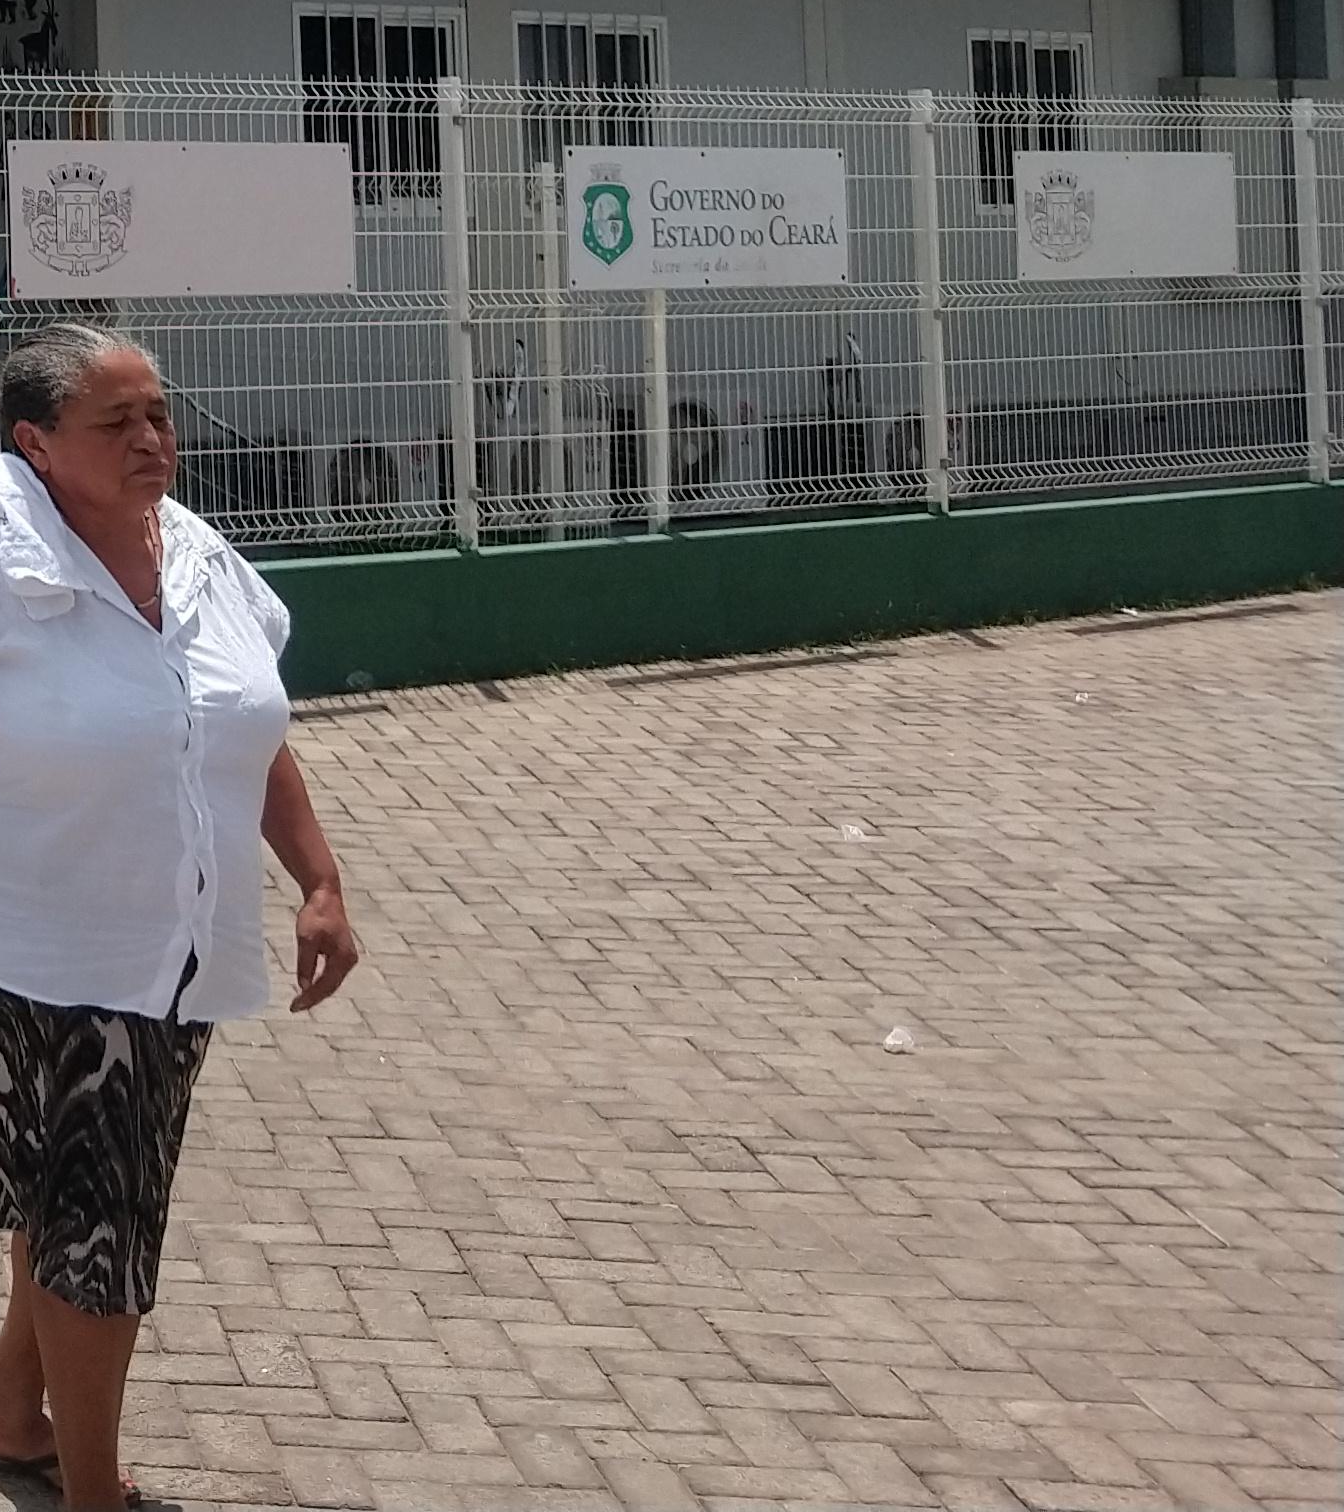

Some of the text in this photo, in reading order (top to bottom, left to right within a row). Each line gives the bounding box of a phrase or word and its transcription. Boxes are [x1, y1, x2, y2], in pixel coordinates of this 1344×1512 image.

[649, 180, 785, 211] GOVERNO DO
[651, 215, 839, 248] ESTADO DO CEARÁ
